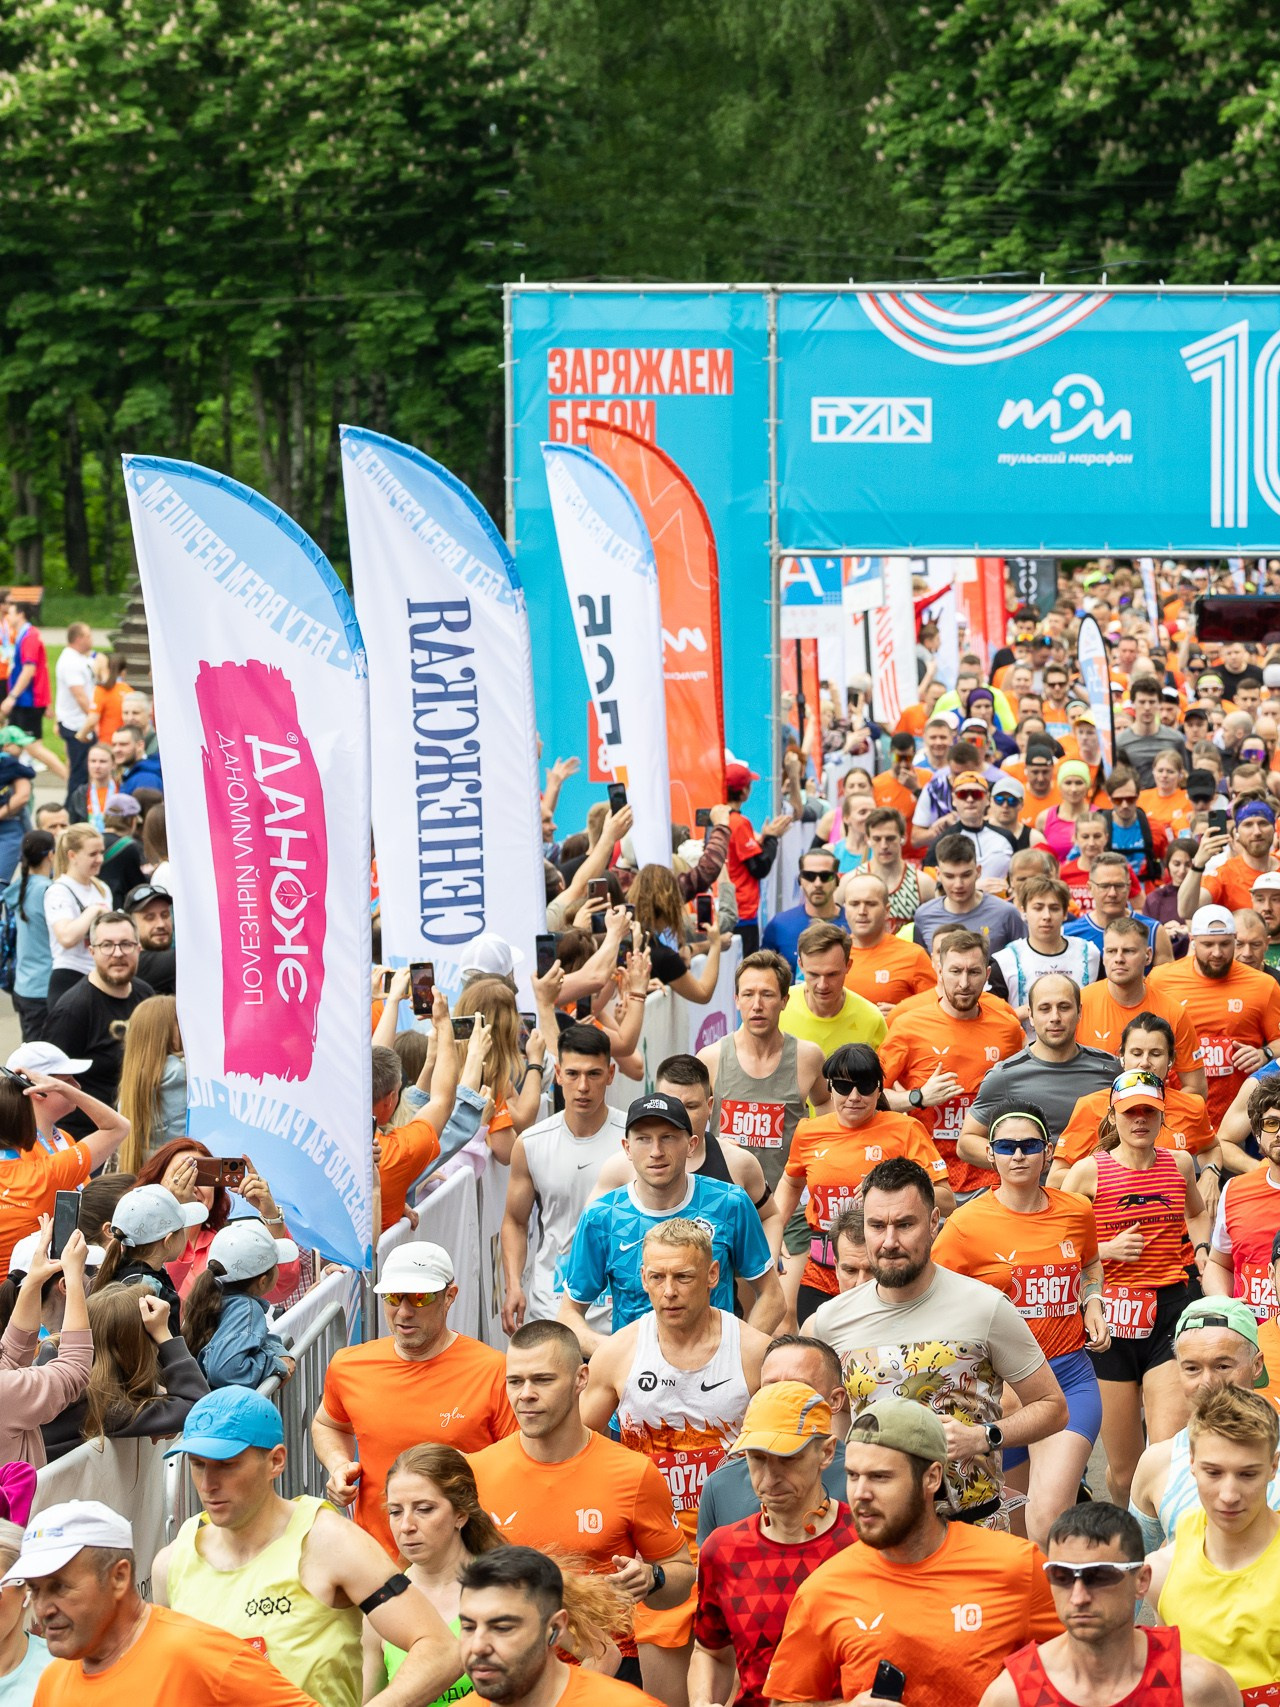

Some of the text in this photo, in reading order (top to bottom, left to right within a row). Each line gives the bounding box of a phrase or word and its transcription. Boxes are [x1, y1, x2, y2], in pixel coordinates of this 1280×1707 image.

[548, 347, 733, 395] ЗАРЯЖАЕМ
[998, 452, 1133, 467] тульский марафон
[984, 1046, 1000, 1062] 10
[732, 1111, 771, 1136] 5013
[1172, 1132, 1187, 1149] 10
[865, 1145, 883, 1162] 10
[1059, 1240, 1076, 1258] 10
[1043, 1265, 1054, 1276] 10
[1026, 1276, 1070, 1305] 5367
[1118, 1287, 1129, 1298] 10
[1104, 1298, 1143, 1326] 5107
[661, 1379, 676, 1387] NN
[440, 1407, 465, 1427] uglow
[674, 1452, 688, 1464] 10
[575, 1508, 604, 1534] 10
[951, 1603, 983, 1632] 10
